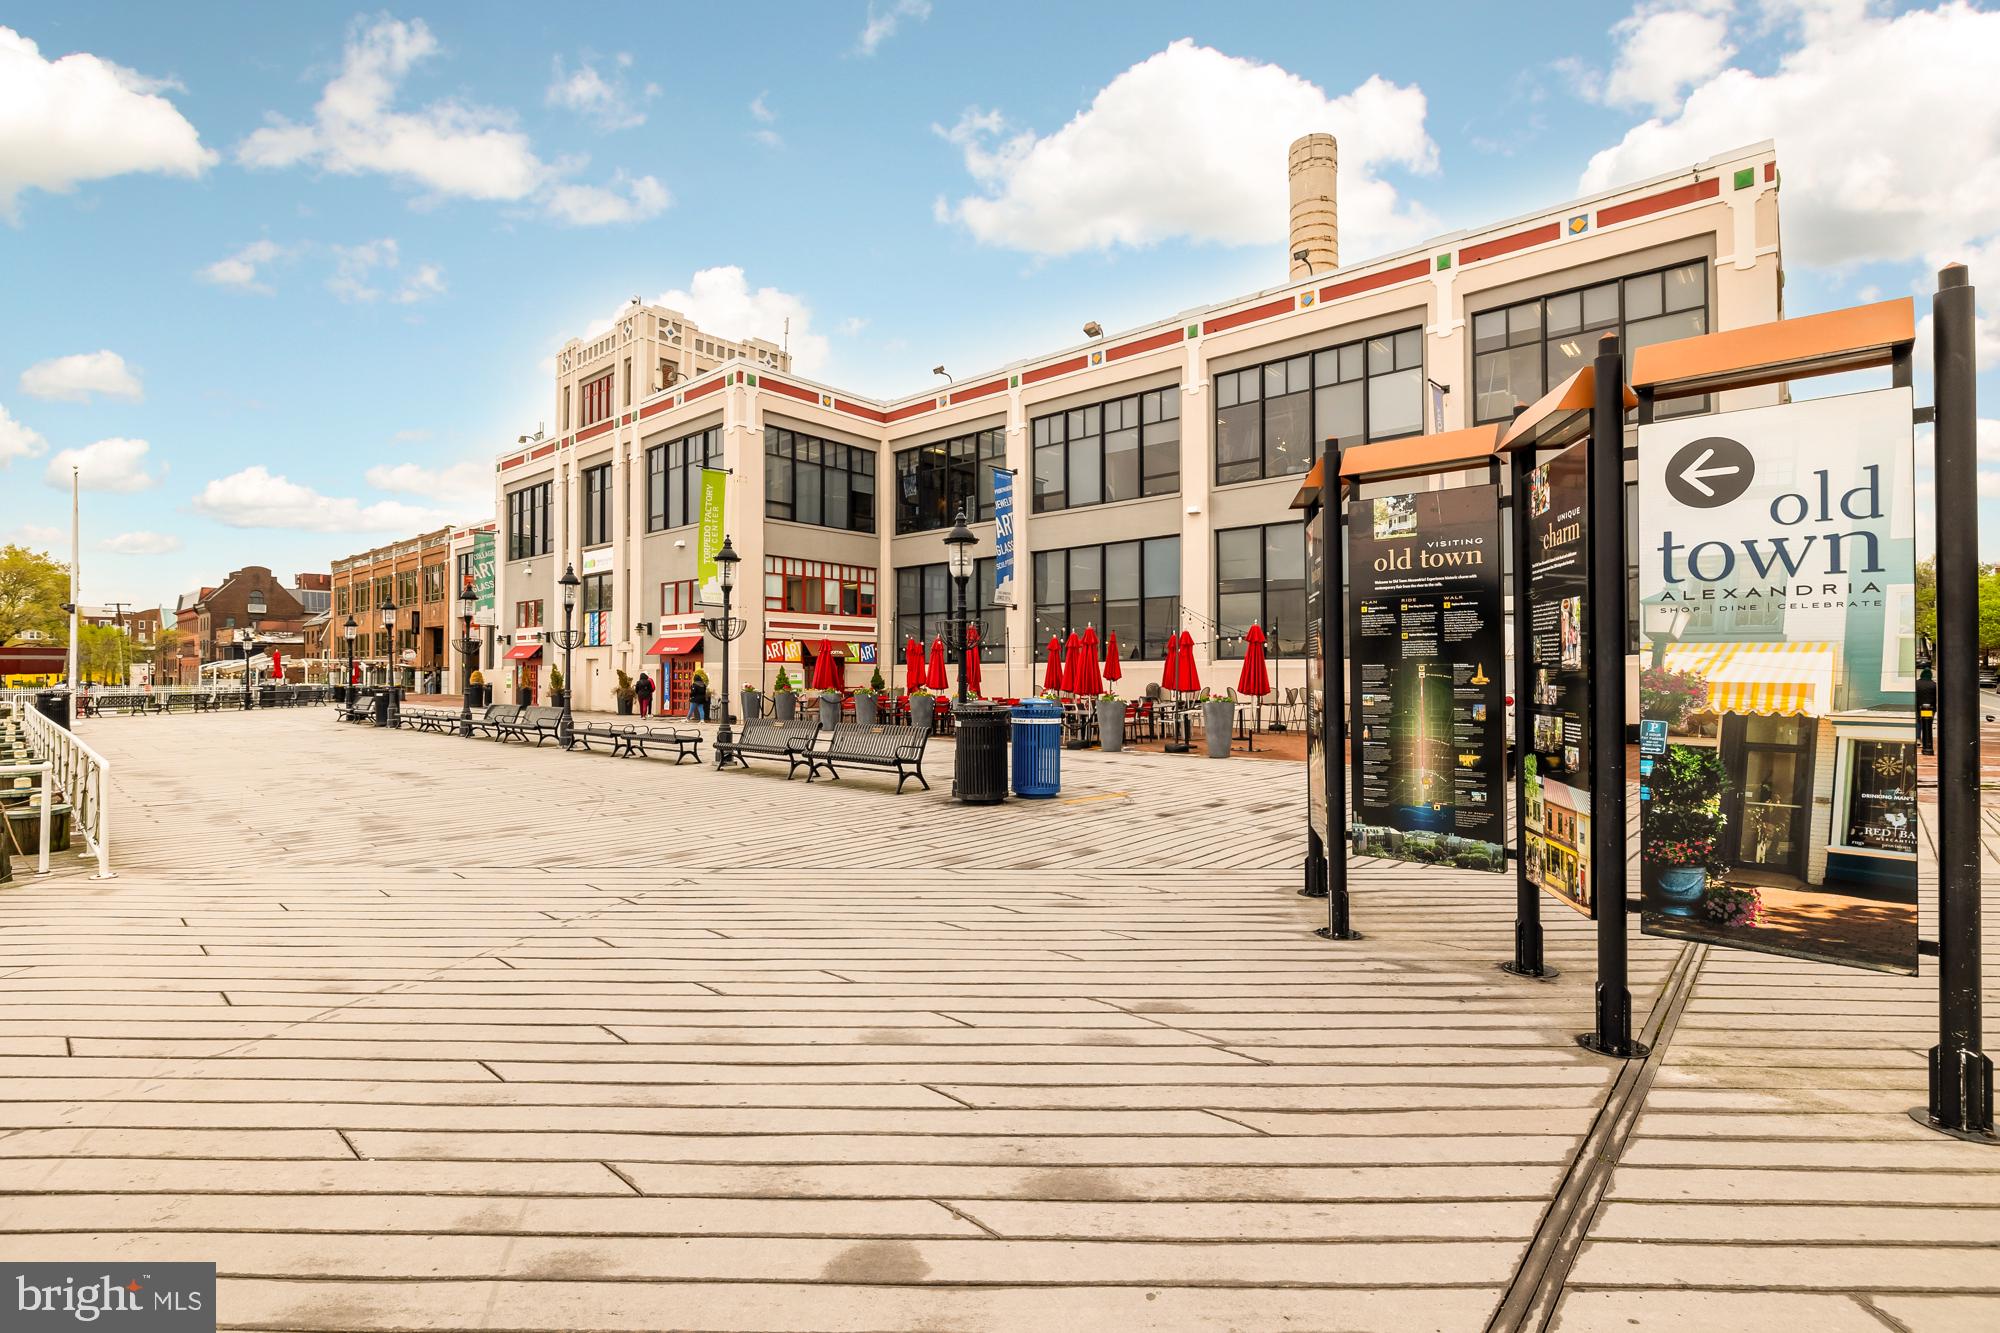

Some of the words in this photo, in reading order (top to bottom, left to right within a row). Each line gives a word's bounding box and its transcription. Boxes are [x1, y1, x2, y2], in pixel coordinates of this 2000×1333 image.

[704, 483, 714, 523] FACTORY
[1769, 464, 1884, 525] old
[1557, 506, 1581, 522] UNIQUE
[711, 506, 719, 543] CENTER
[703, 525, 712, 564] TORPEDO
[1427, 538, 1483, 548] VISITING
[1543, 522, 1581, 550] charm
[1374, 547, 1412, 572] old
[1420, 548, 1483, 568] town
[1657, 530, 1886, 584] town
[473, 561, 495, 580] ART
[472, 580, 494, 593] GLASS
[1660, 581, 1881, 602] ALEXANDRIA
[1660, 606, 1701, 614] SHOP
[1719, 604, 1758, 612] DINE
[1777, 600, 1882, 610] CELEBRATE
[765, 641, 784, 660] ART
[785, 641, 801, 660] ART
[861, 643, 875, 661] ART
[1650, 723, 1658, 732] P
[1865, 827, 1892, 837] RED
